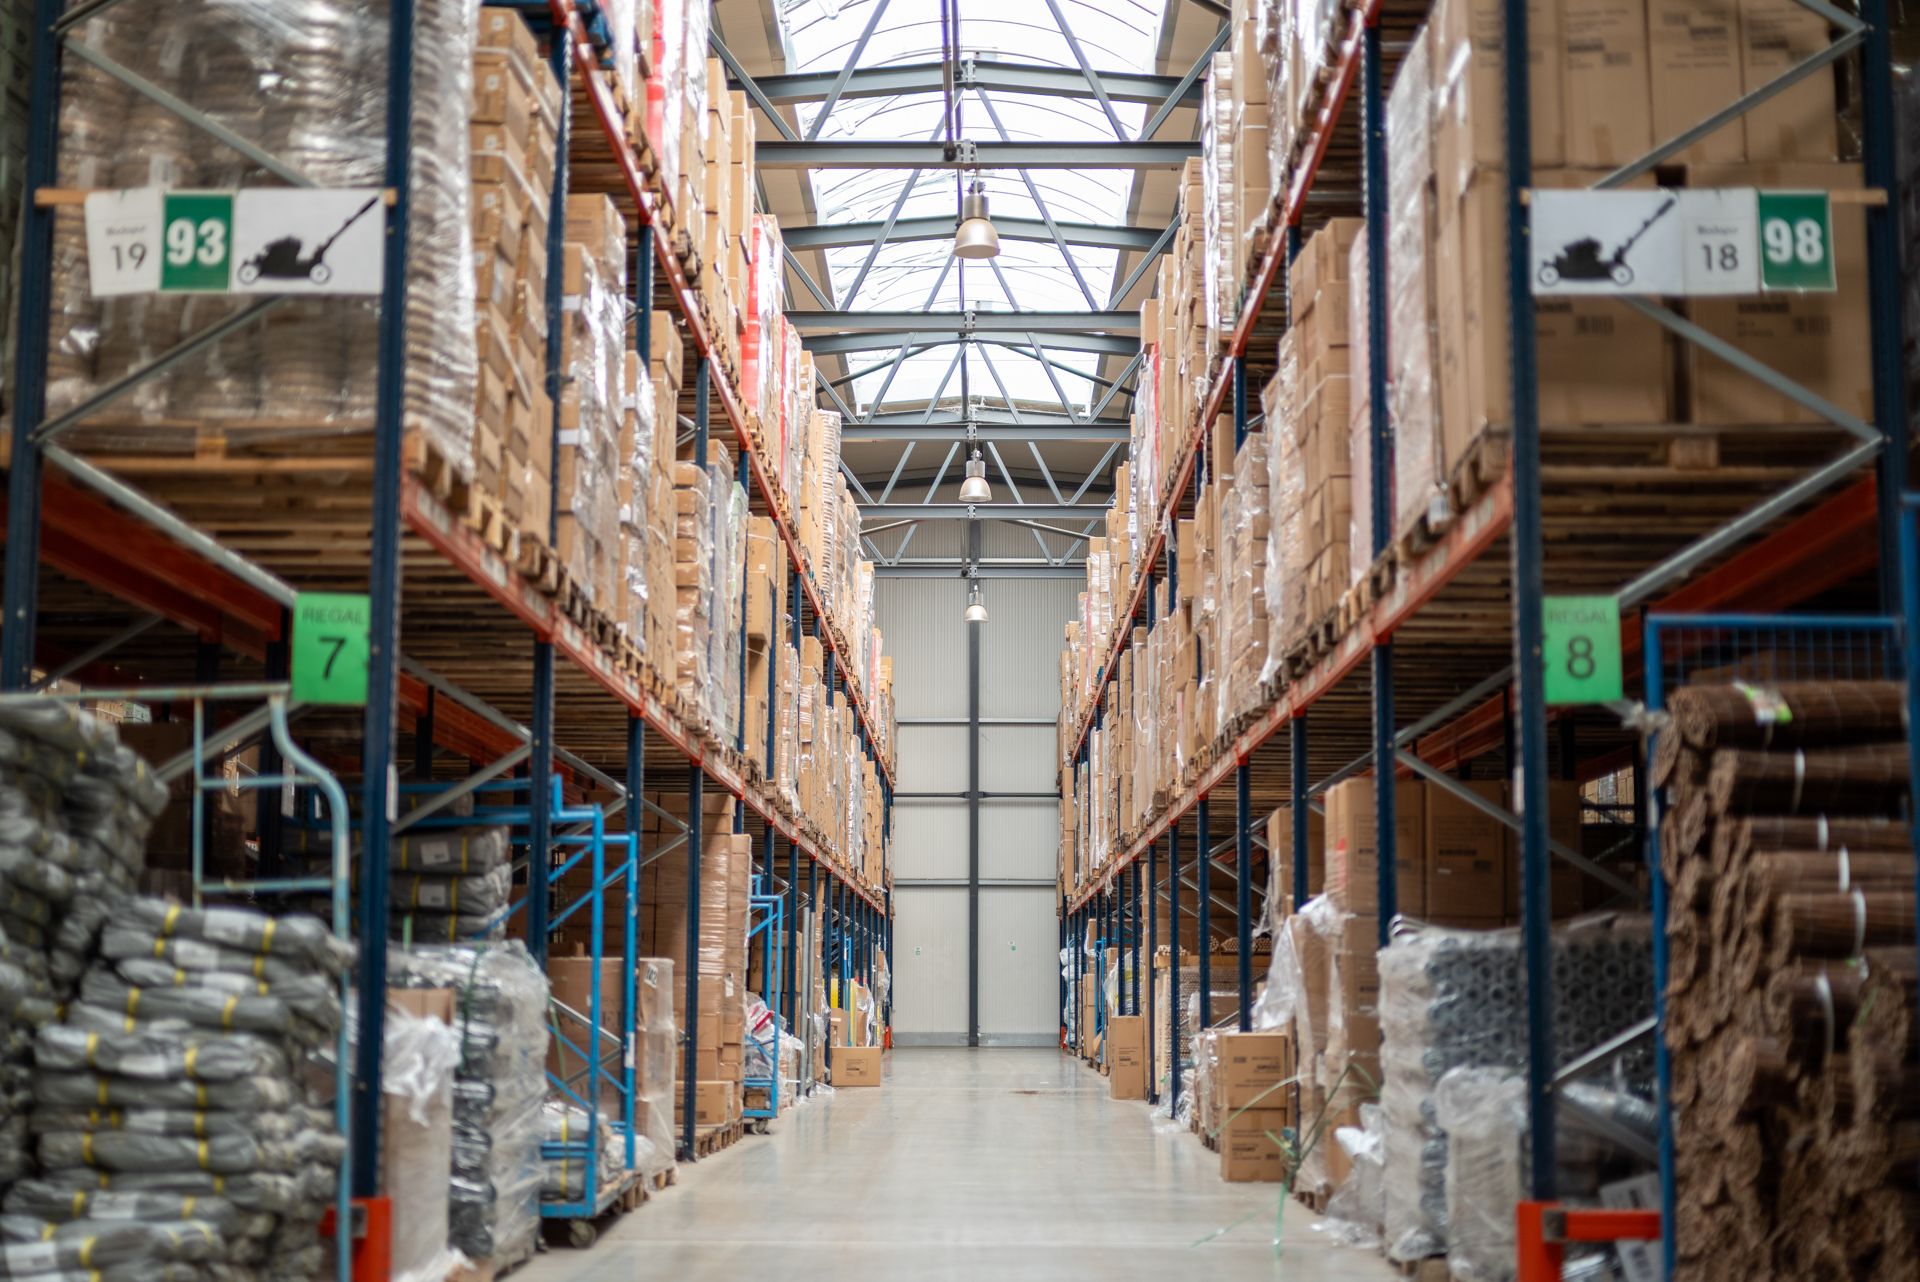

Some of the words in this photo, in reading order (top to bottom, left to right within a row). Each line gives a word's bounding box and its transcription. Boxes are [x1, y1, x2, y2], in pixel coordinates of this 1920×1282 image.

[111, 243, 147, 271] 19
[166, 218, 227, 266] 93
[1702, 243, 1739, 272] 18
[1763, 217, 1824, 264] 98
[302, 606, 365, 624] REGAL
[318, 635, 347, 681] 7
[1567, 635, 1596, 681] 8
